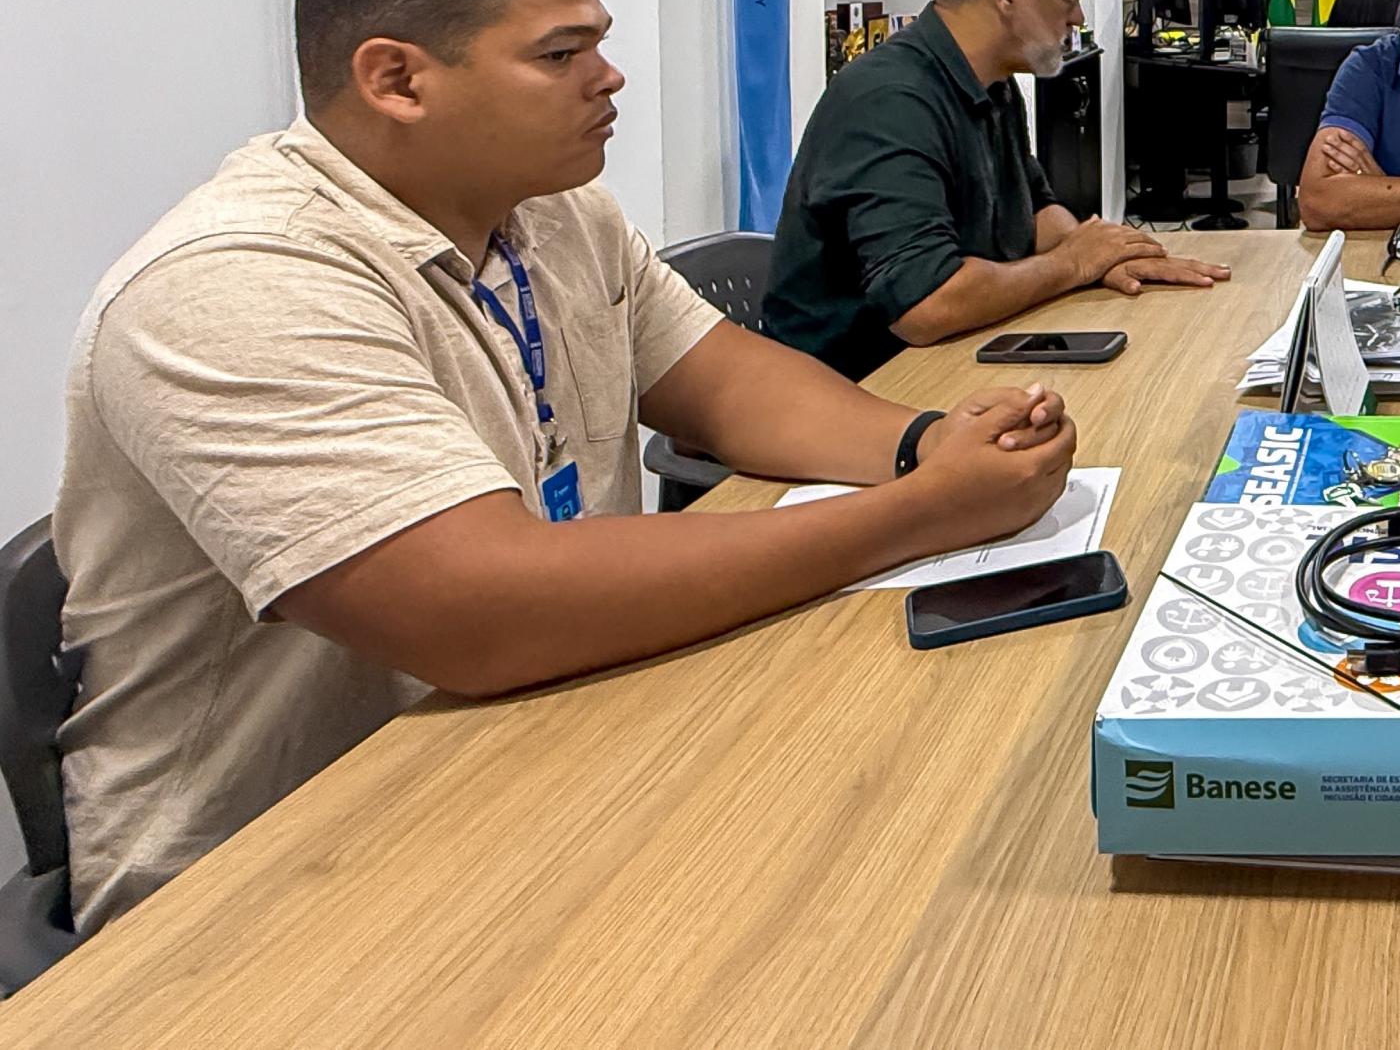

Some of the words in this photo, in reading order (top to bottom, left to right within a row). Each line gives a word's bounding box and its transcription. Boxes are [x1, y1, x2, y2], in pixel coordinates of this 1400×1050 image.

[1239, 425, 1304, 505] SEASIC
[1186, 773, 1297, 800] Banese
[1322, 775, 1374, 784] SECRETARIA
[1376, 775, 1387, 784] DE
